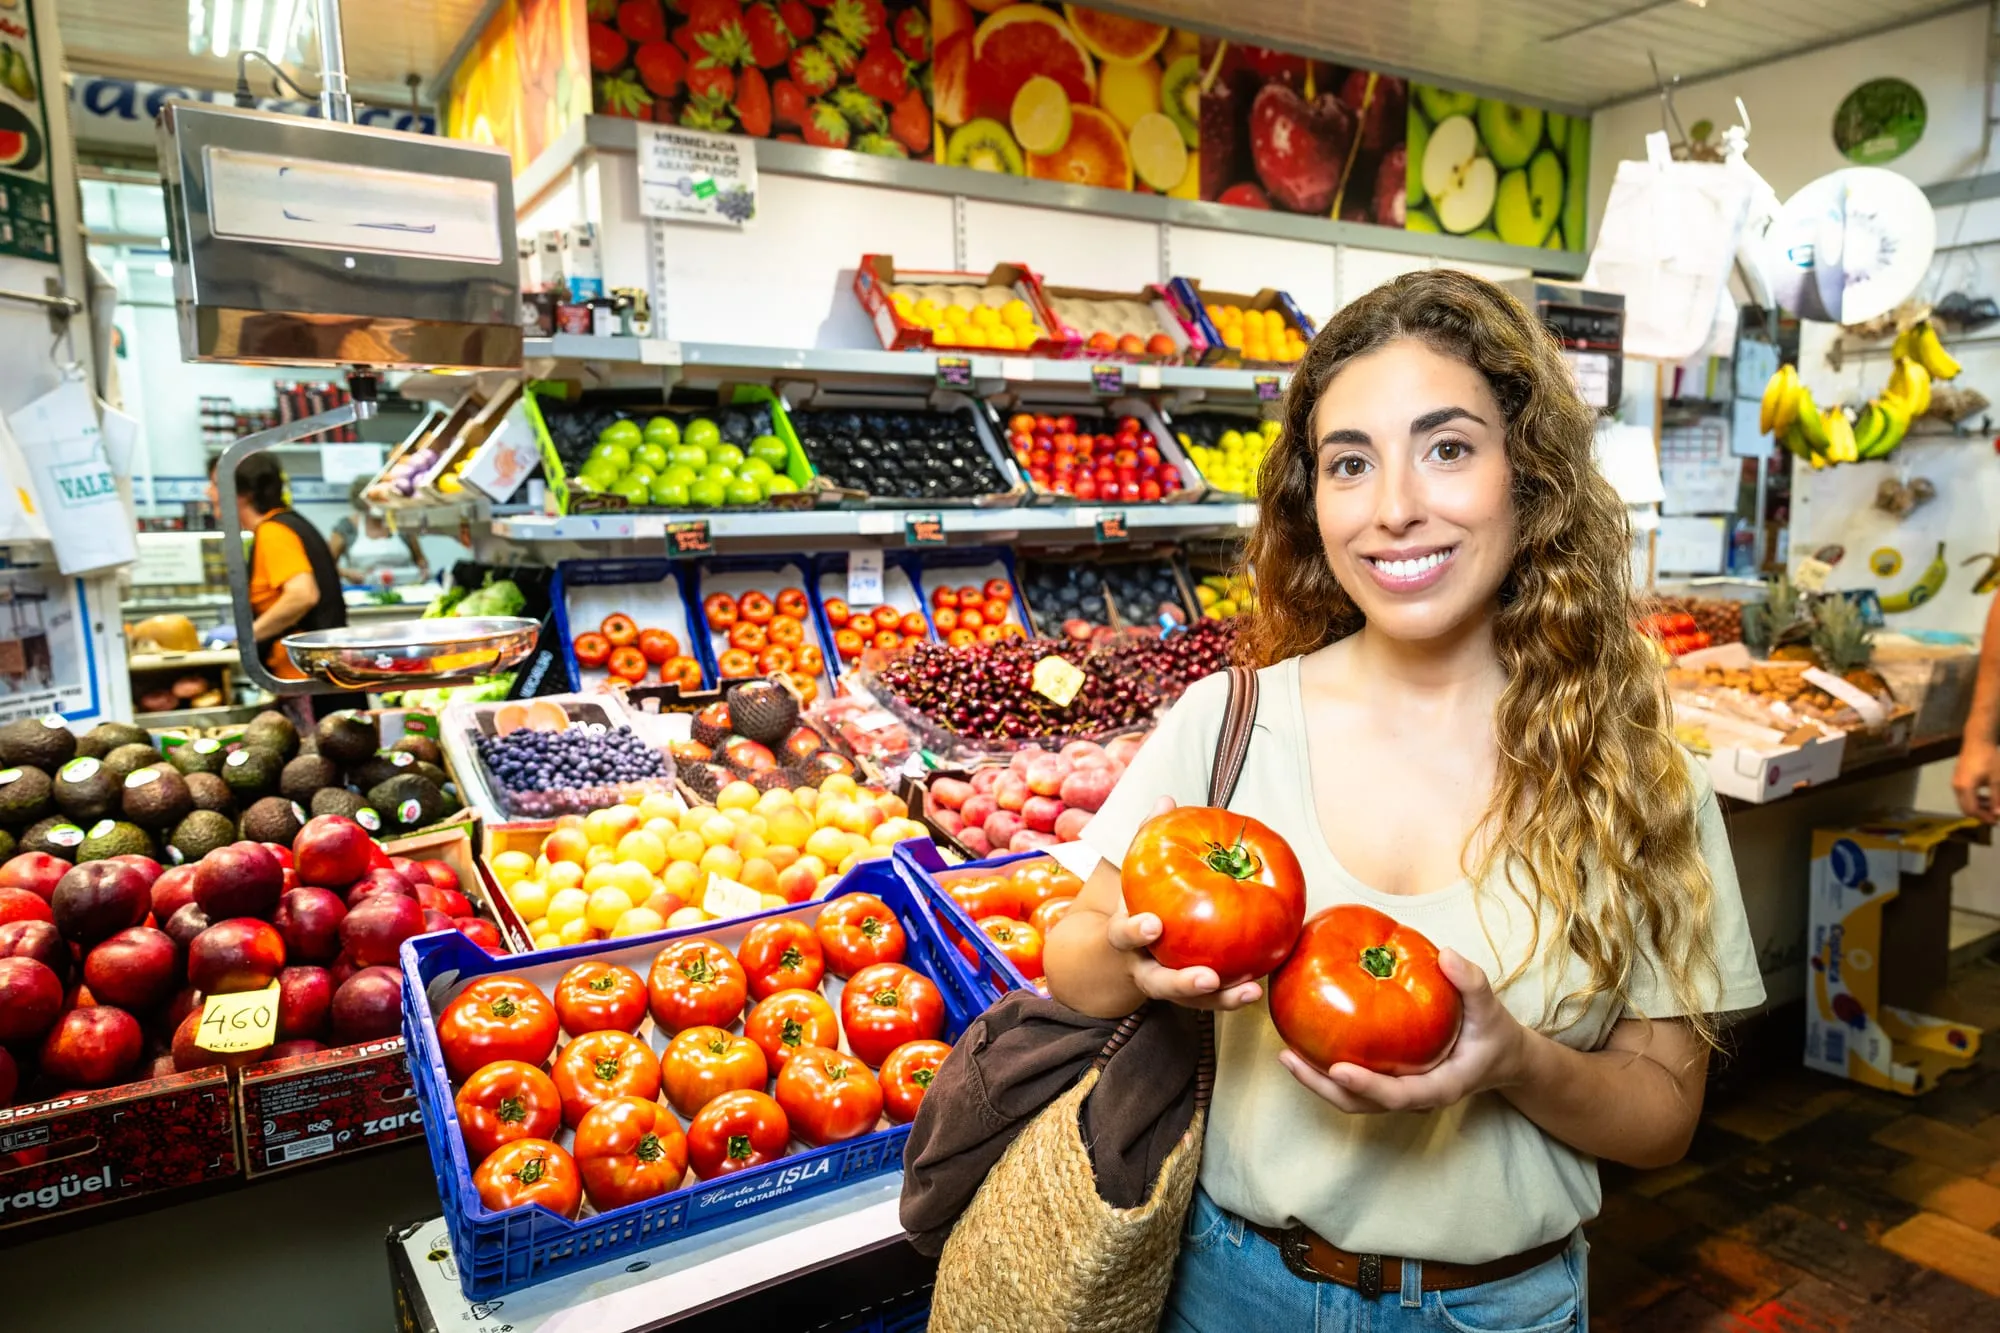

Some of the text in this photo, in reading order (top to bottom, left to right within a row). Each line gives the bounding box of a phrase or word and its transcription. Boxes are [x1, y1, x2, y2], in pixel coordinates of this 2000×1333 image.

[700, 1157, 831, 1208] Huerta de ISLA
[734, 1184, 793, 1208] CANTABRIA
